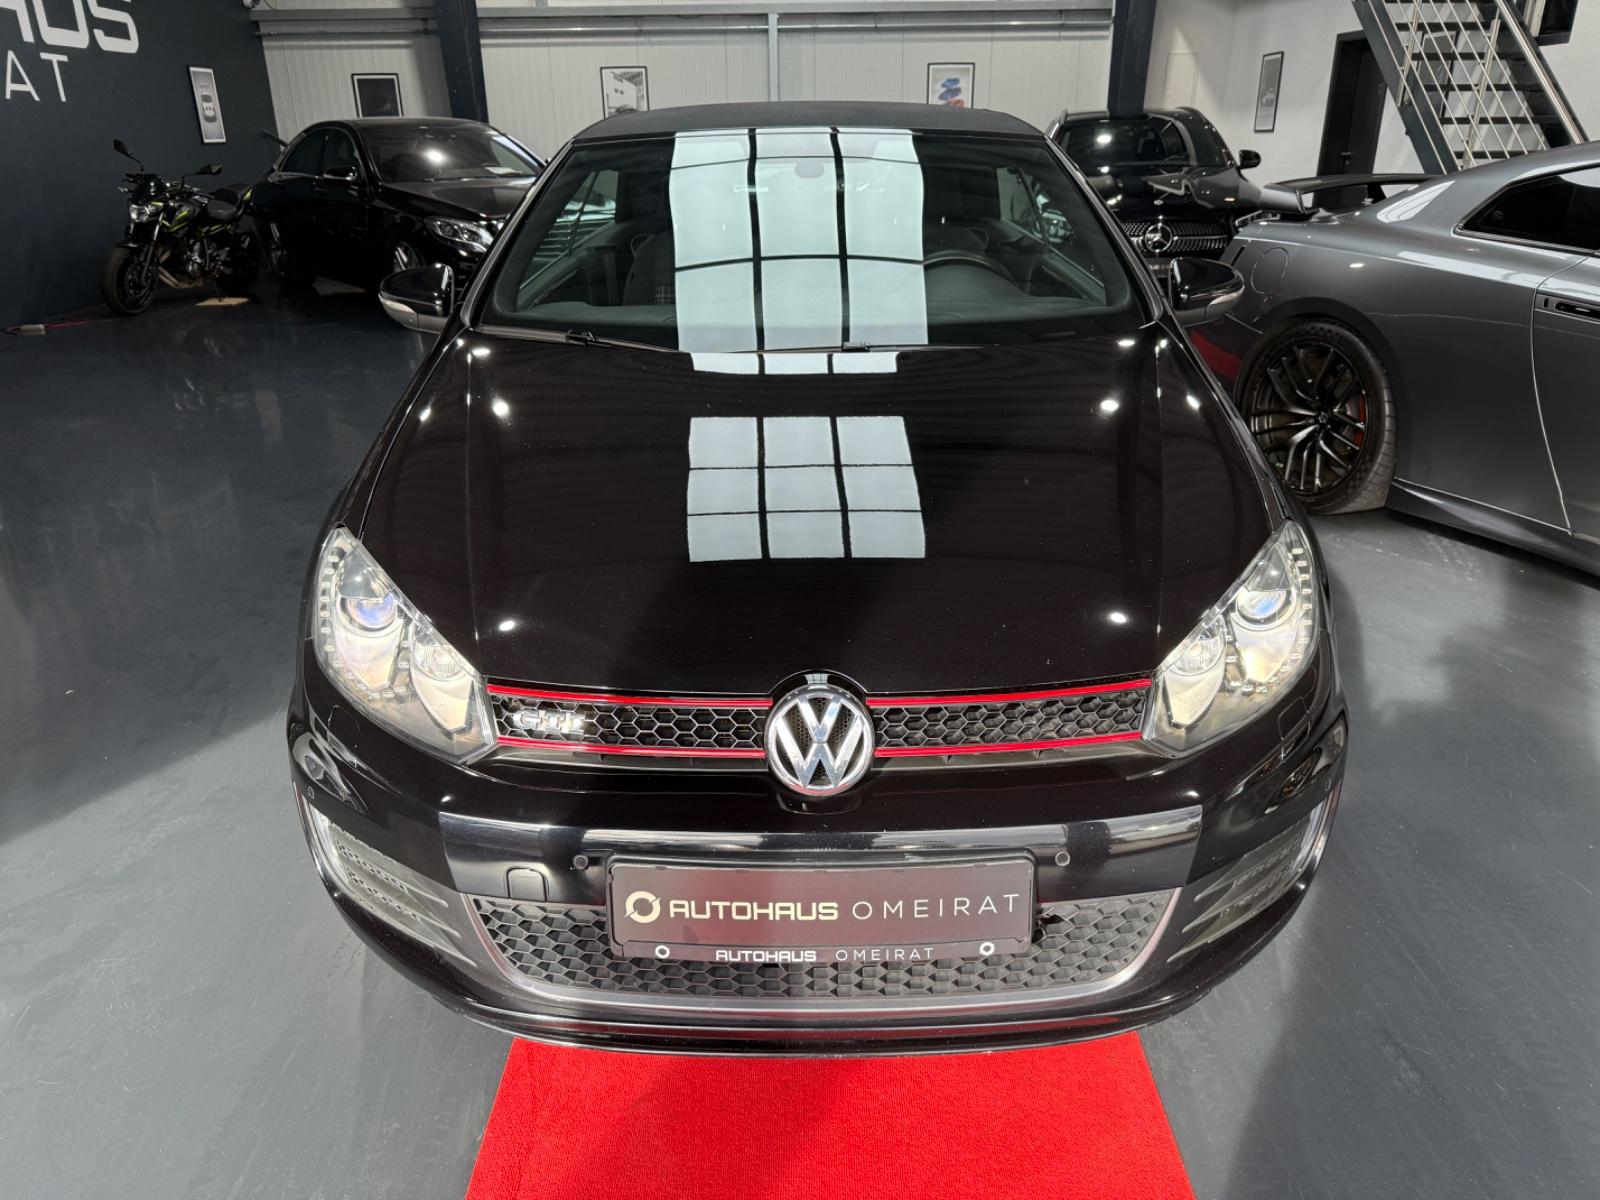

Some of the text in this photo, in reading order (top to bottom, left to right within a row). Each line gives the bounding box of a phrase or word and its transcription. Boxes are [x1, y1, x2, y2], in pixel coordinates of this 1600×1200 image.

[5, 50, 68, 102] AT
[770, 691, 869, 790] VW
[669, 894, 1019, 921] AUTOHAUS OMEIRAT
[715, 948, 934, 962] AUTOHAUS OMEIRAT
